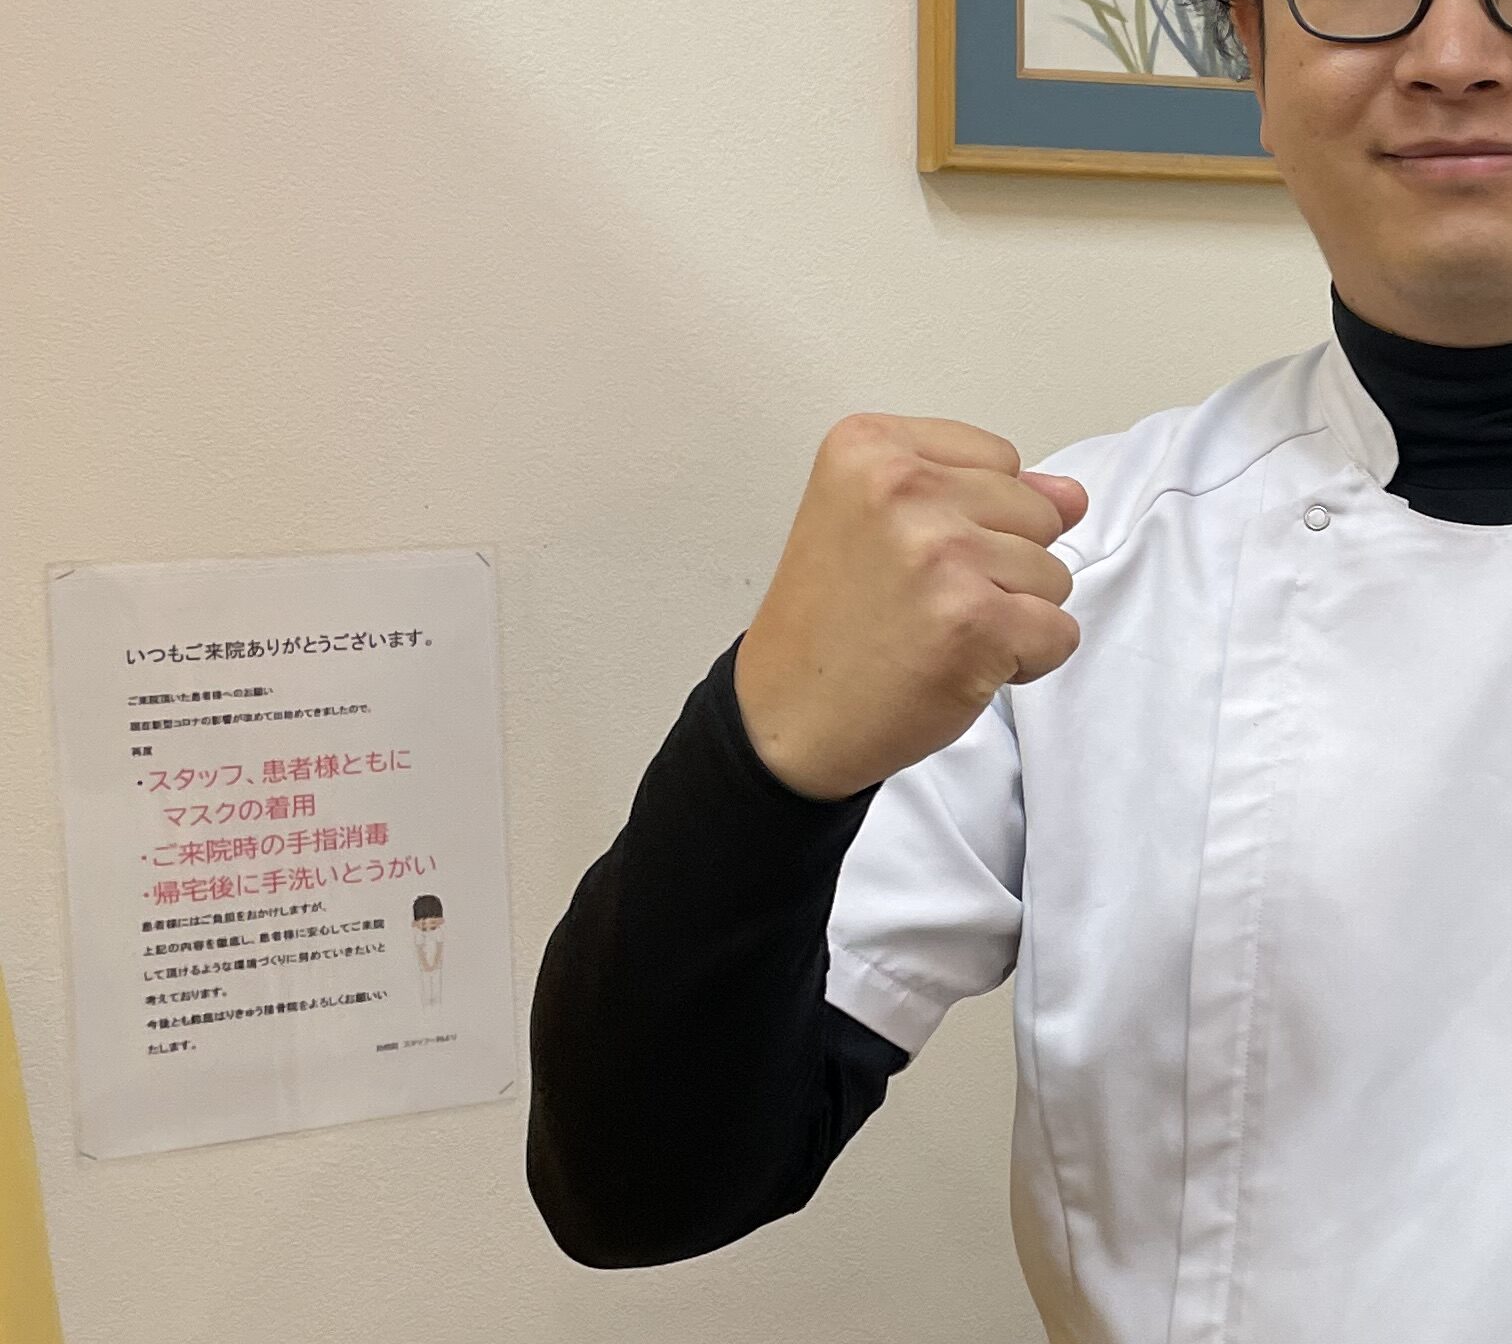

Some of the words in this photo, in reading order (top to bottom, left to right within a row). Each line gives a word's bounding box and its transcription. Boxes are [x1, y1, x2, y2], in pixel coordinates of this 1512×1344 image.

[126, 628, 432, 665] いつもご来院ありがとうございます。
[163, 794, 315, 827] マスクの着用
[144, 986, 227, 1006] 考えております。
[148, 1040, 196, 1055] たします。
